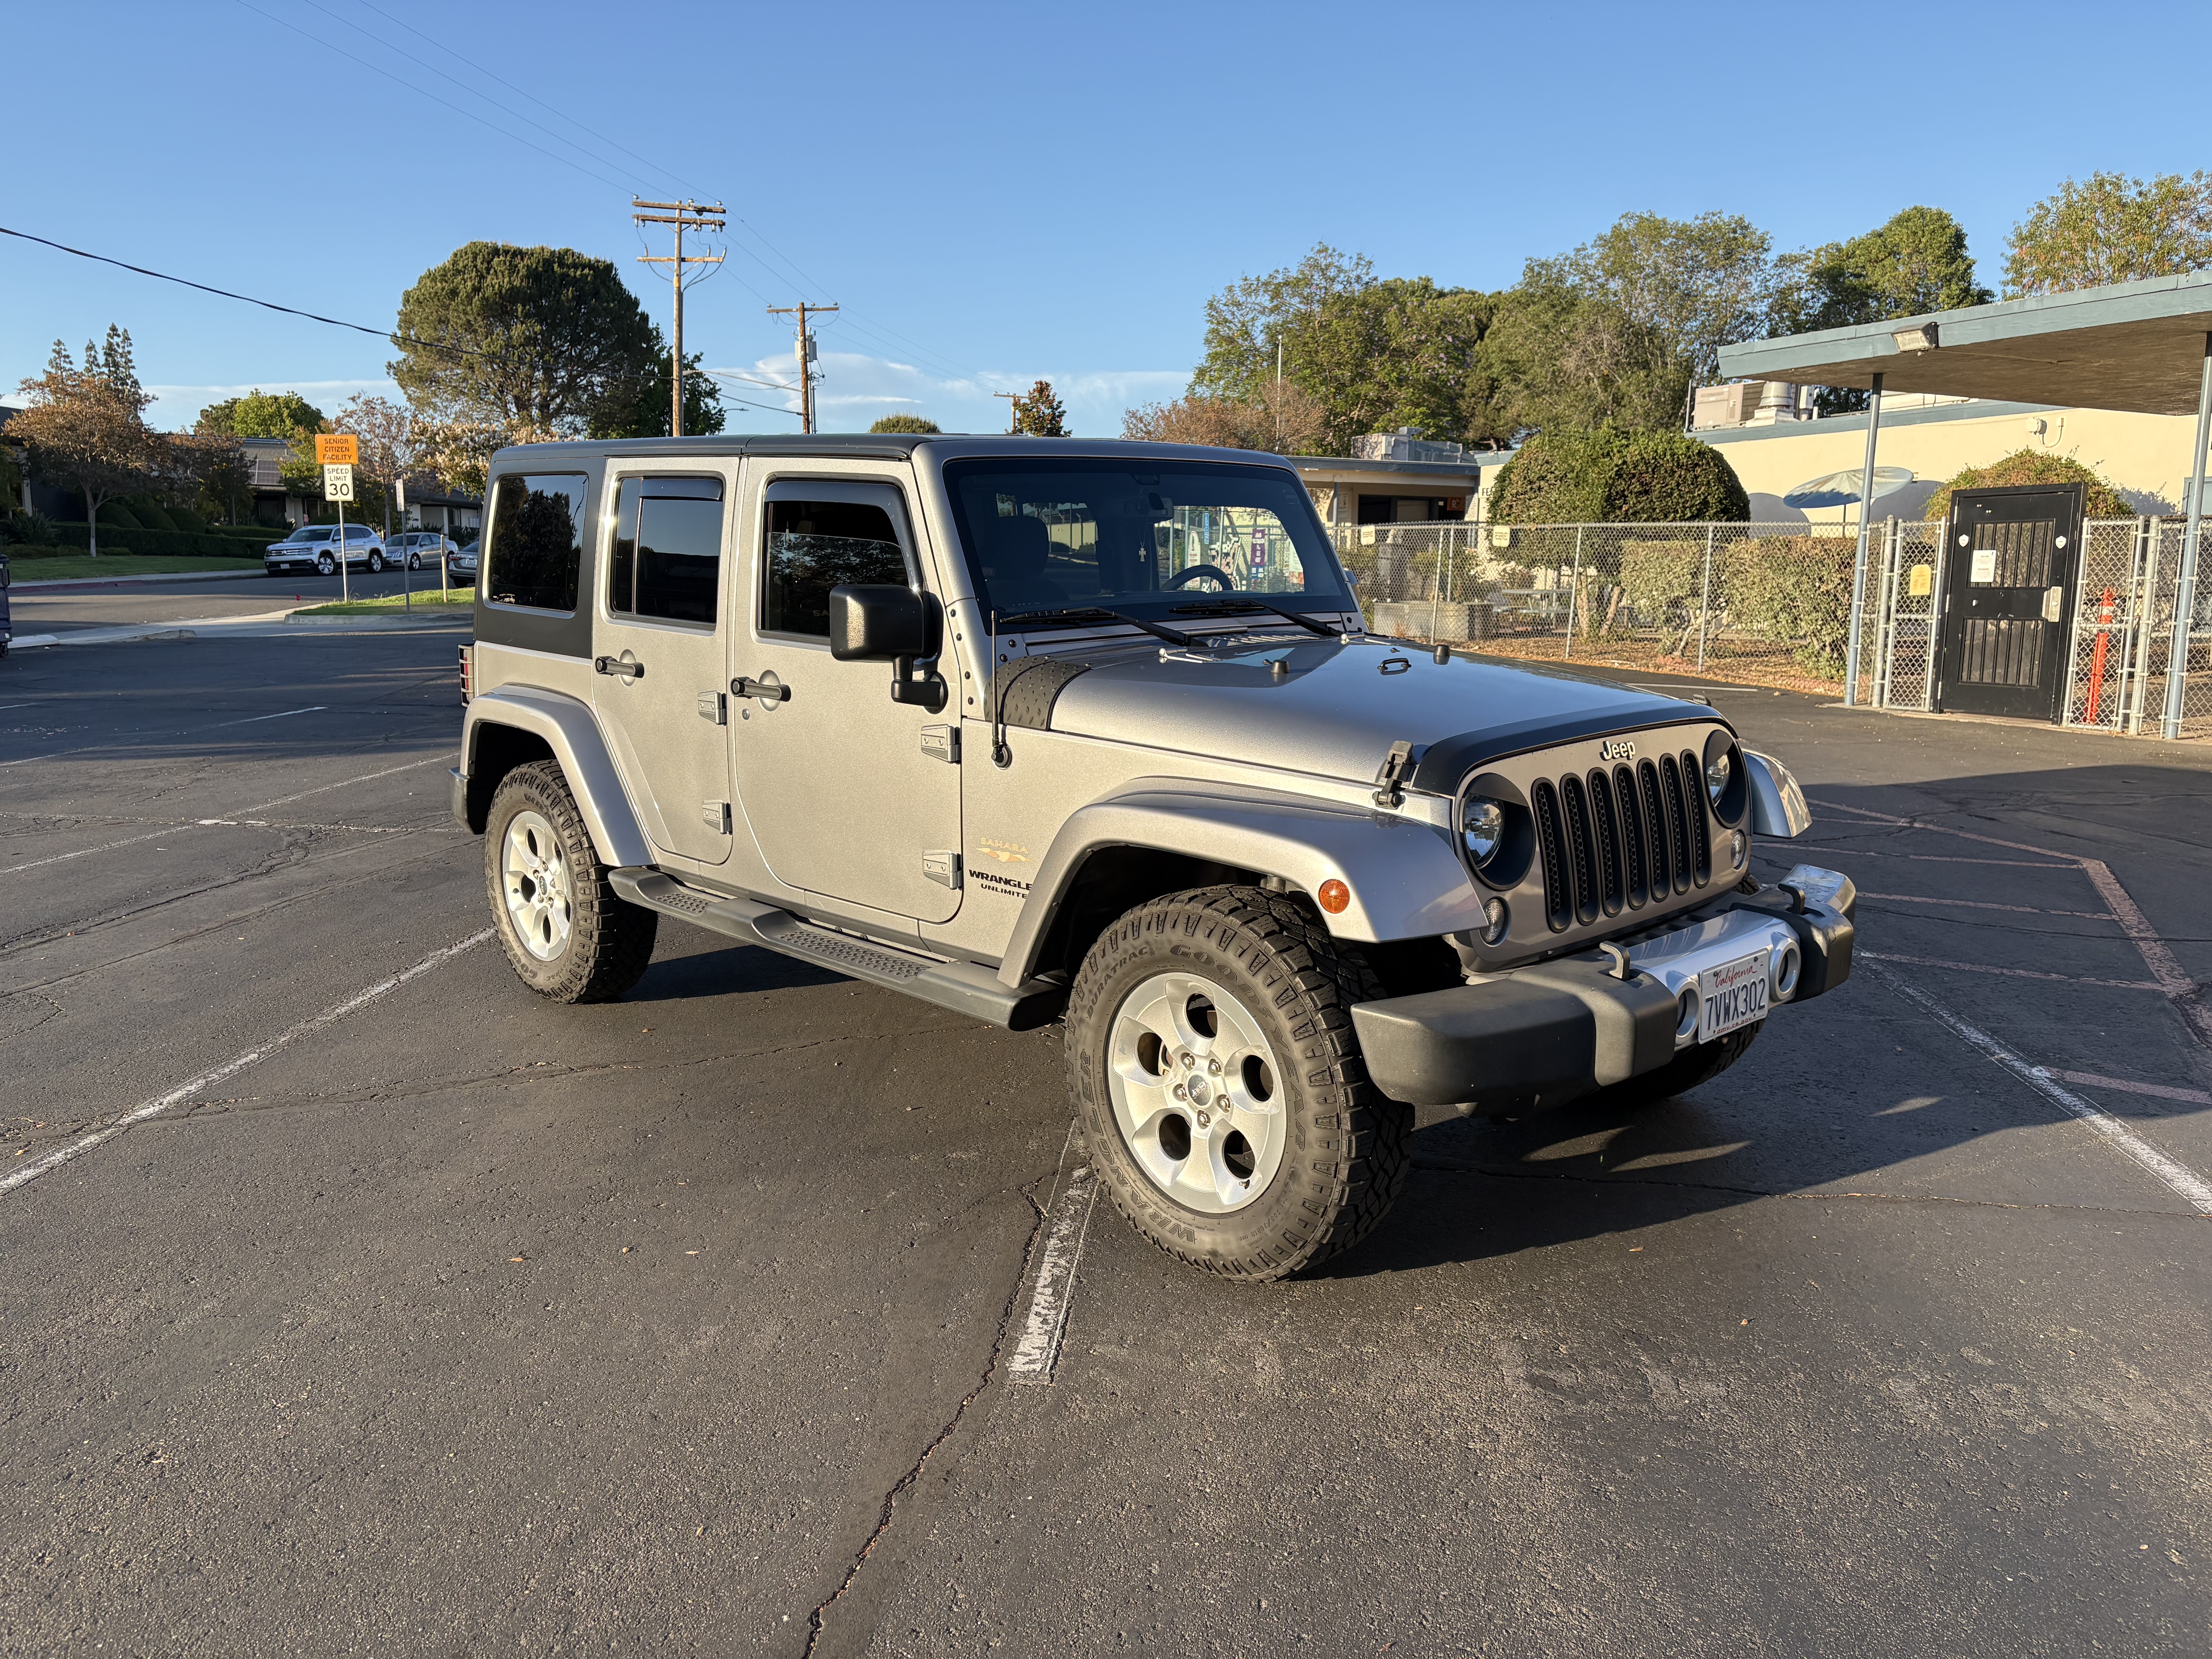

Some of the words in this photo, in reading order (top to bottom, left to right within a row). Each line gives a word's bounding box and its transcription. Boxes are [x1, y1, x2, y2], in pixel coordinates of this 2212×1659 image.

[329, 483, 349, 496] 30
[1600, 740, 1636, 761] Jeep
[980, 837, 1028, 854] SAHARA
[1087, 947, 1148, 1020] DURATRAC
[1715, 965, 1757, 988] California
[1705, 977, 1765, 1030] 7VWX302
[1717, 1017, 1752, 1034] dmv.ca.gov
[1170, 944, 1305, 1151] GOODYEAR
[1080, 1048, 1195, 1244] WRANGLER
